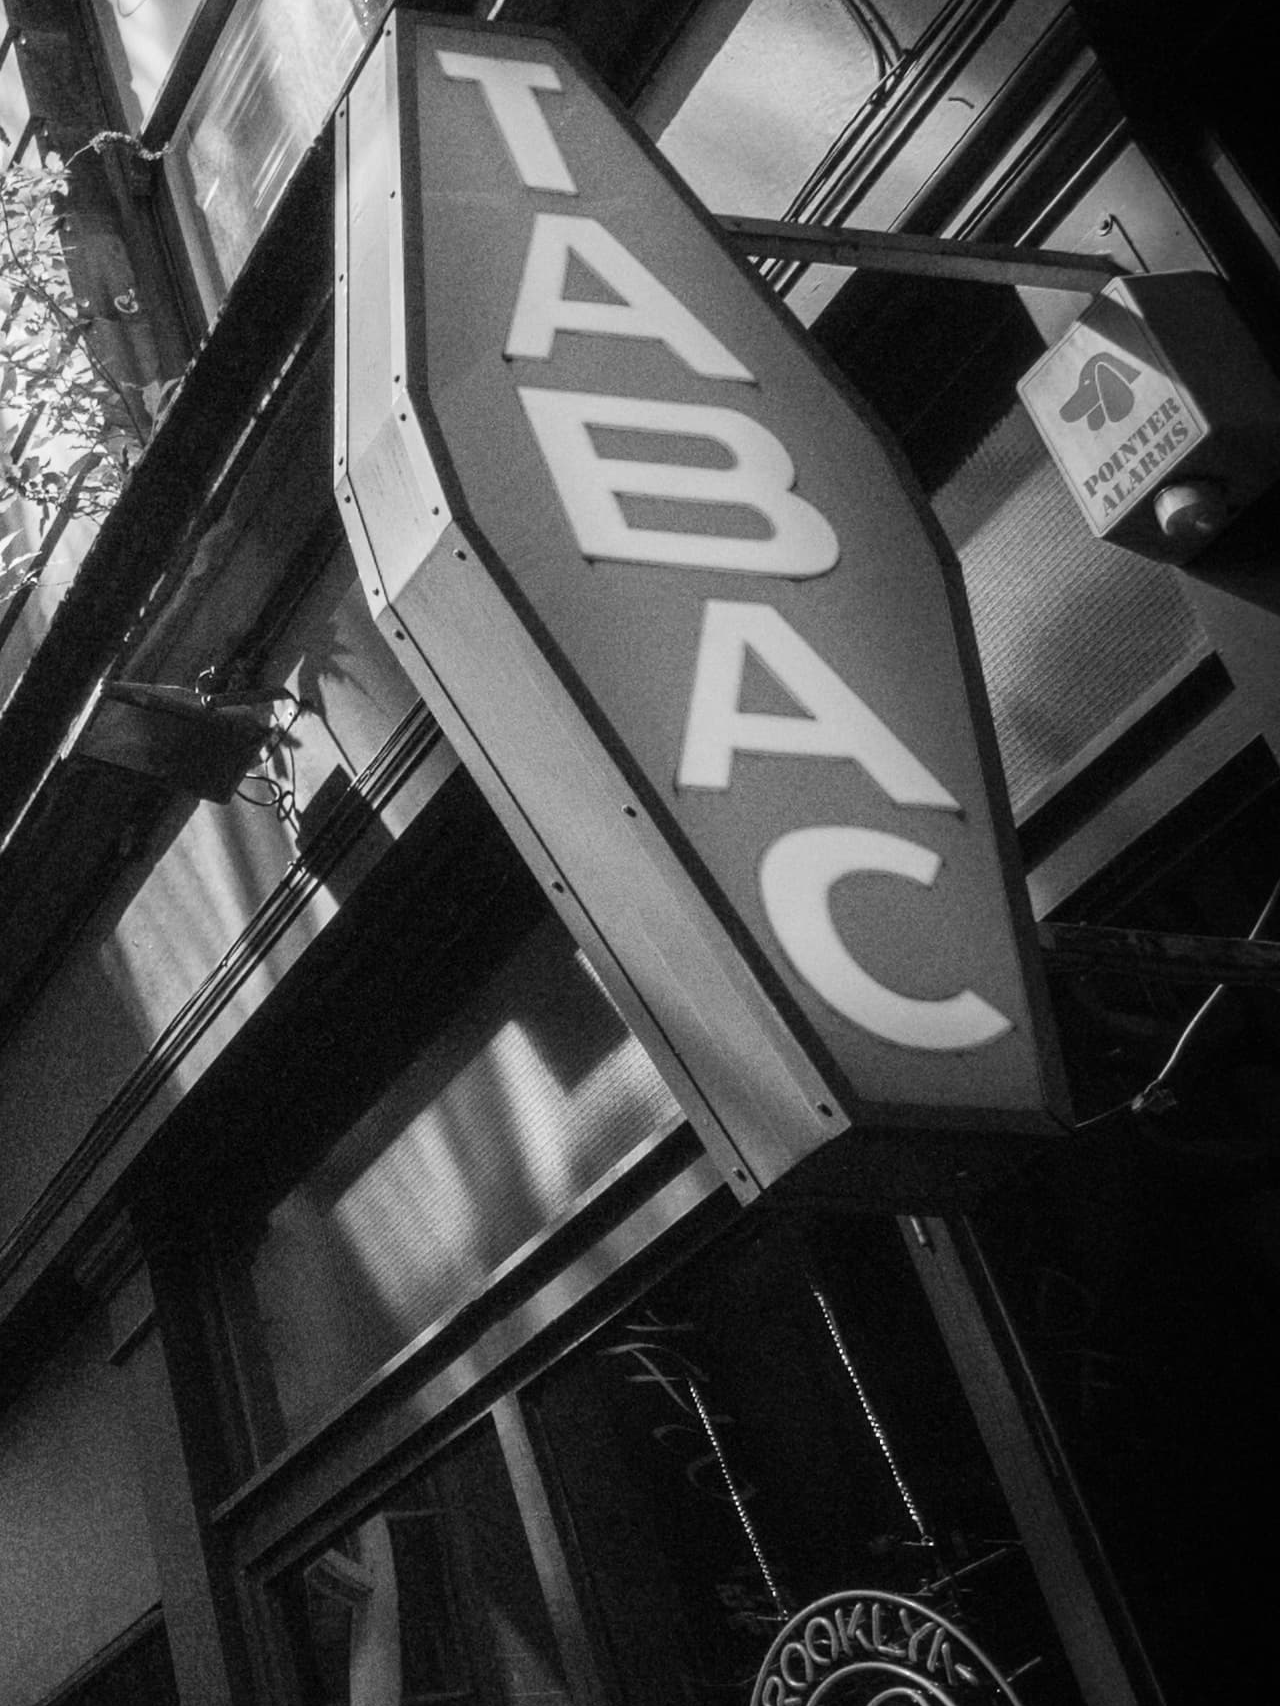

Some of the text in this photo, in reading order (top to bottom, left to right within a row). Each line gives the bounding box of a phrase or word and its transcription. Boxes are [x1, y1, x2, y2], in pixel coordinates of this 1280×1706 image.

[1083, 397, 1181, 498] POINTER
[1098, 421, 1189, 518] ALARMS
[438, 50, 1015, 1050] TABAC
